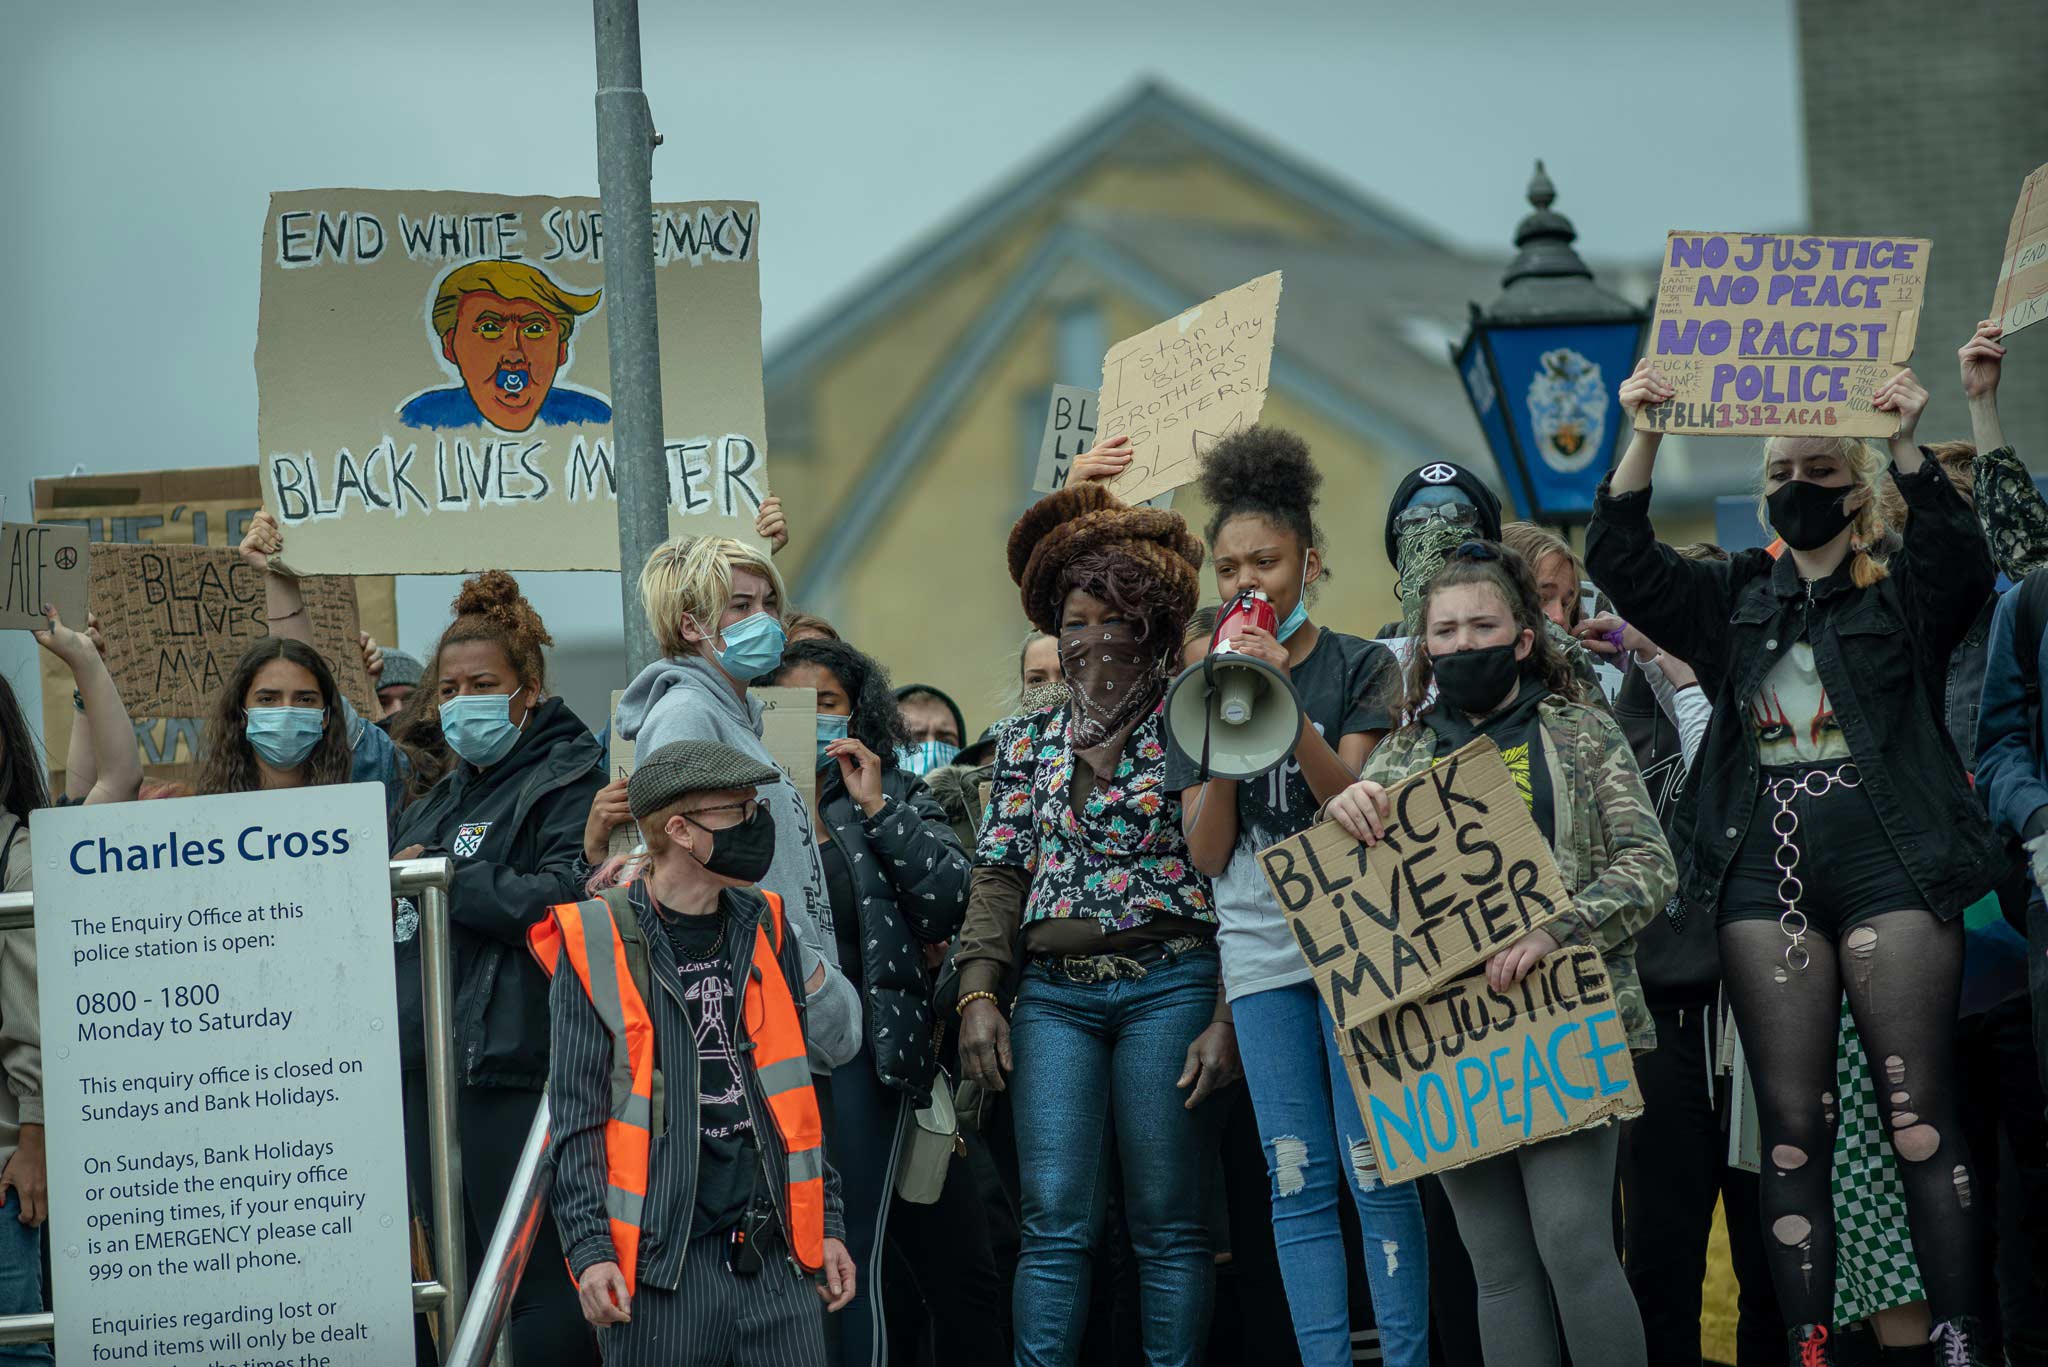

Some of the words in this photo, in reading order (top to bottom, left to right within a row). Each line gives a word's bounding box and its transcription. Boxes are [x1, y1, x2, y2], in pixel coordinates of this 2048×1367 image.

[282, 212, 384, 262] END
[400, 211, 522, 259] WHITE
[543, 208, 754, 262] SUPMACY
[1670, 236, 1730, 269] NO
[1734, 236, 1919, 271] JUSTICE
[2019, 243, 2047, 268] END
[1694, 275, 1759, 307] NO
[1767, 274, 1890, 308] PEACE
[1893, 273, 1921, 285] FUCK
[1230, 316, 1263, 340] my
[1656, 319, 1732, 356] NO
[1738, 319, 1887, 359] RACIST
[1153, 339, 1235, 390] BLACK
[1711, 363, 1851, 404] POLICE
[1103, 354, 1248, 440] BROTHERS
[1784, 406, 1838, 427] ACAB
[273, 442, 429, 521] BLACK
[439, 441, 550, 504] LIVES
[569, 437, 763, 517] MTER
[0, 527, 51, 617] ACE
[141, 553, 256, 605] BLAC
[166, 599, 270, 640] LIVES
[69, 831, 226, 876] Charles
[236, 825, 351, 862] Cross
[70, 917, 106, 937] The
[111, 912, 183, 935] Enquiry
[187, 907, 243, 927] Office
[246, 905, 267, 923] at
[269, 901, 304, 921] this
[73, 943, 130, 968] police
[134, 938, 198, 958] station
[203, 935, 217, 953] is
[221, 934, 275, 954] open:
[1330, 859, 1556, 1029] MATTER
[76, 990, 137, 1016] 0800
[160, 983, 220, 1009] 1800
[78, 1017, 165, 1043] Monday
[169, 1016, 193, 1035] to
[198, 1006, 293, 1032] Saturday
[1350, 1002, 1437, 1090] NO
[78, 1076, 118, 1095] This
[122, 1071, 194, 1094] enquiry
[198, 1065, 250, 1086] office
[255, 1063, 269, 1081] is
[273, 1057, 334, 1079] closed
[338, 1059, 363, 1074] on
[1368, 1072, 1459, 1172] NO
[1455, 1009, 1631, 1149] PEACE
[81, 1100, 159, 1122] Sundays
[164, 1094, 199, 1115] and
[204, 1090, 251, 1112] Bank
[255, 1086, 339, 1108] Holidays.
[83, 1157, 111, 1175] On
[116, 1151, 199, 1173] Sundays,
[203, 1144, 250, 1165] Bank
[254, 1139, 334, 1161] Holidays
[85, 1187, 105, 1202] or
[109, 1177, 179, 1200] outside
[183, 1175, 215, 1193] the
[219, 1169, 292, 1193] enquiry
[296, 1164, 348, 1184] office
[86, 1207, 165, 1232] opening
[169, 1203, 226, 1221] times,
[230, 1197, 243, 1216] if
[246, 1198, 289, 1220] your
[293, 1190, 366, 1213] enquiry
[88, 1237, 102, 1255] is
[106, 1239, 129, 1254] an
[134, 1224, 252, 1251] EMERGENCY
[256, 1221, 317, 1245] please
[321, 1215, 352, 1236] call
[88, 1262, 123, 1282] 999
[128, 1263, 153, 1278] on
[156, 1257, 189, 1276] the
[192, 1252, 231, 1273] wall
[236, 1250, 302, 1274] phone.
[92, 1312, 178, 1337] Enquiries
[183, 1304, 274, 1330] regarding
[279, 1301, 313, 1320] lost
[317, 1302, 337, 1316] or
[92, 1339, 148, 1362] found
[153, 1339, 205, 1357] items
[209, 1331, 241, 1352] will
[246, 1328, 287, 1351] only
[292, 1327, 316, 1345] be
[320, 1322, 369, 1343] dealt
